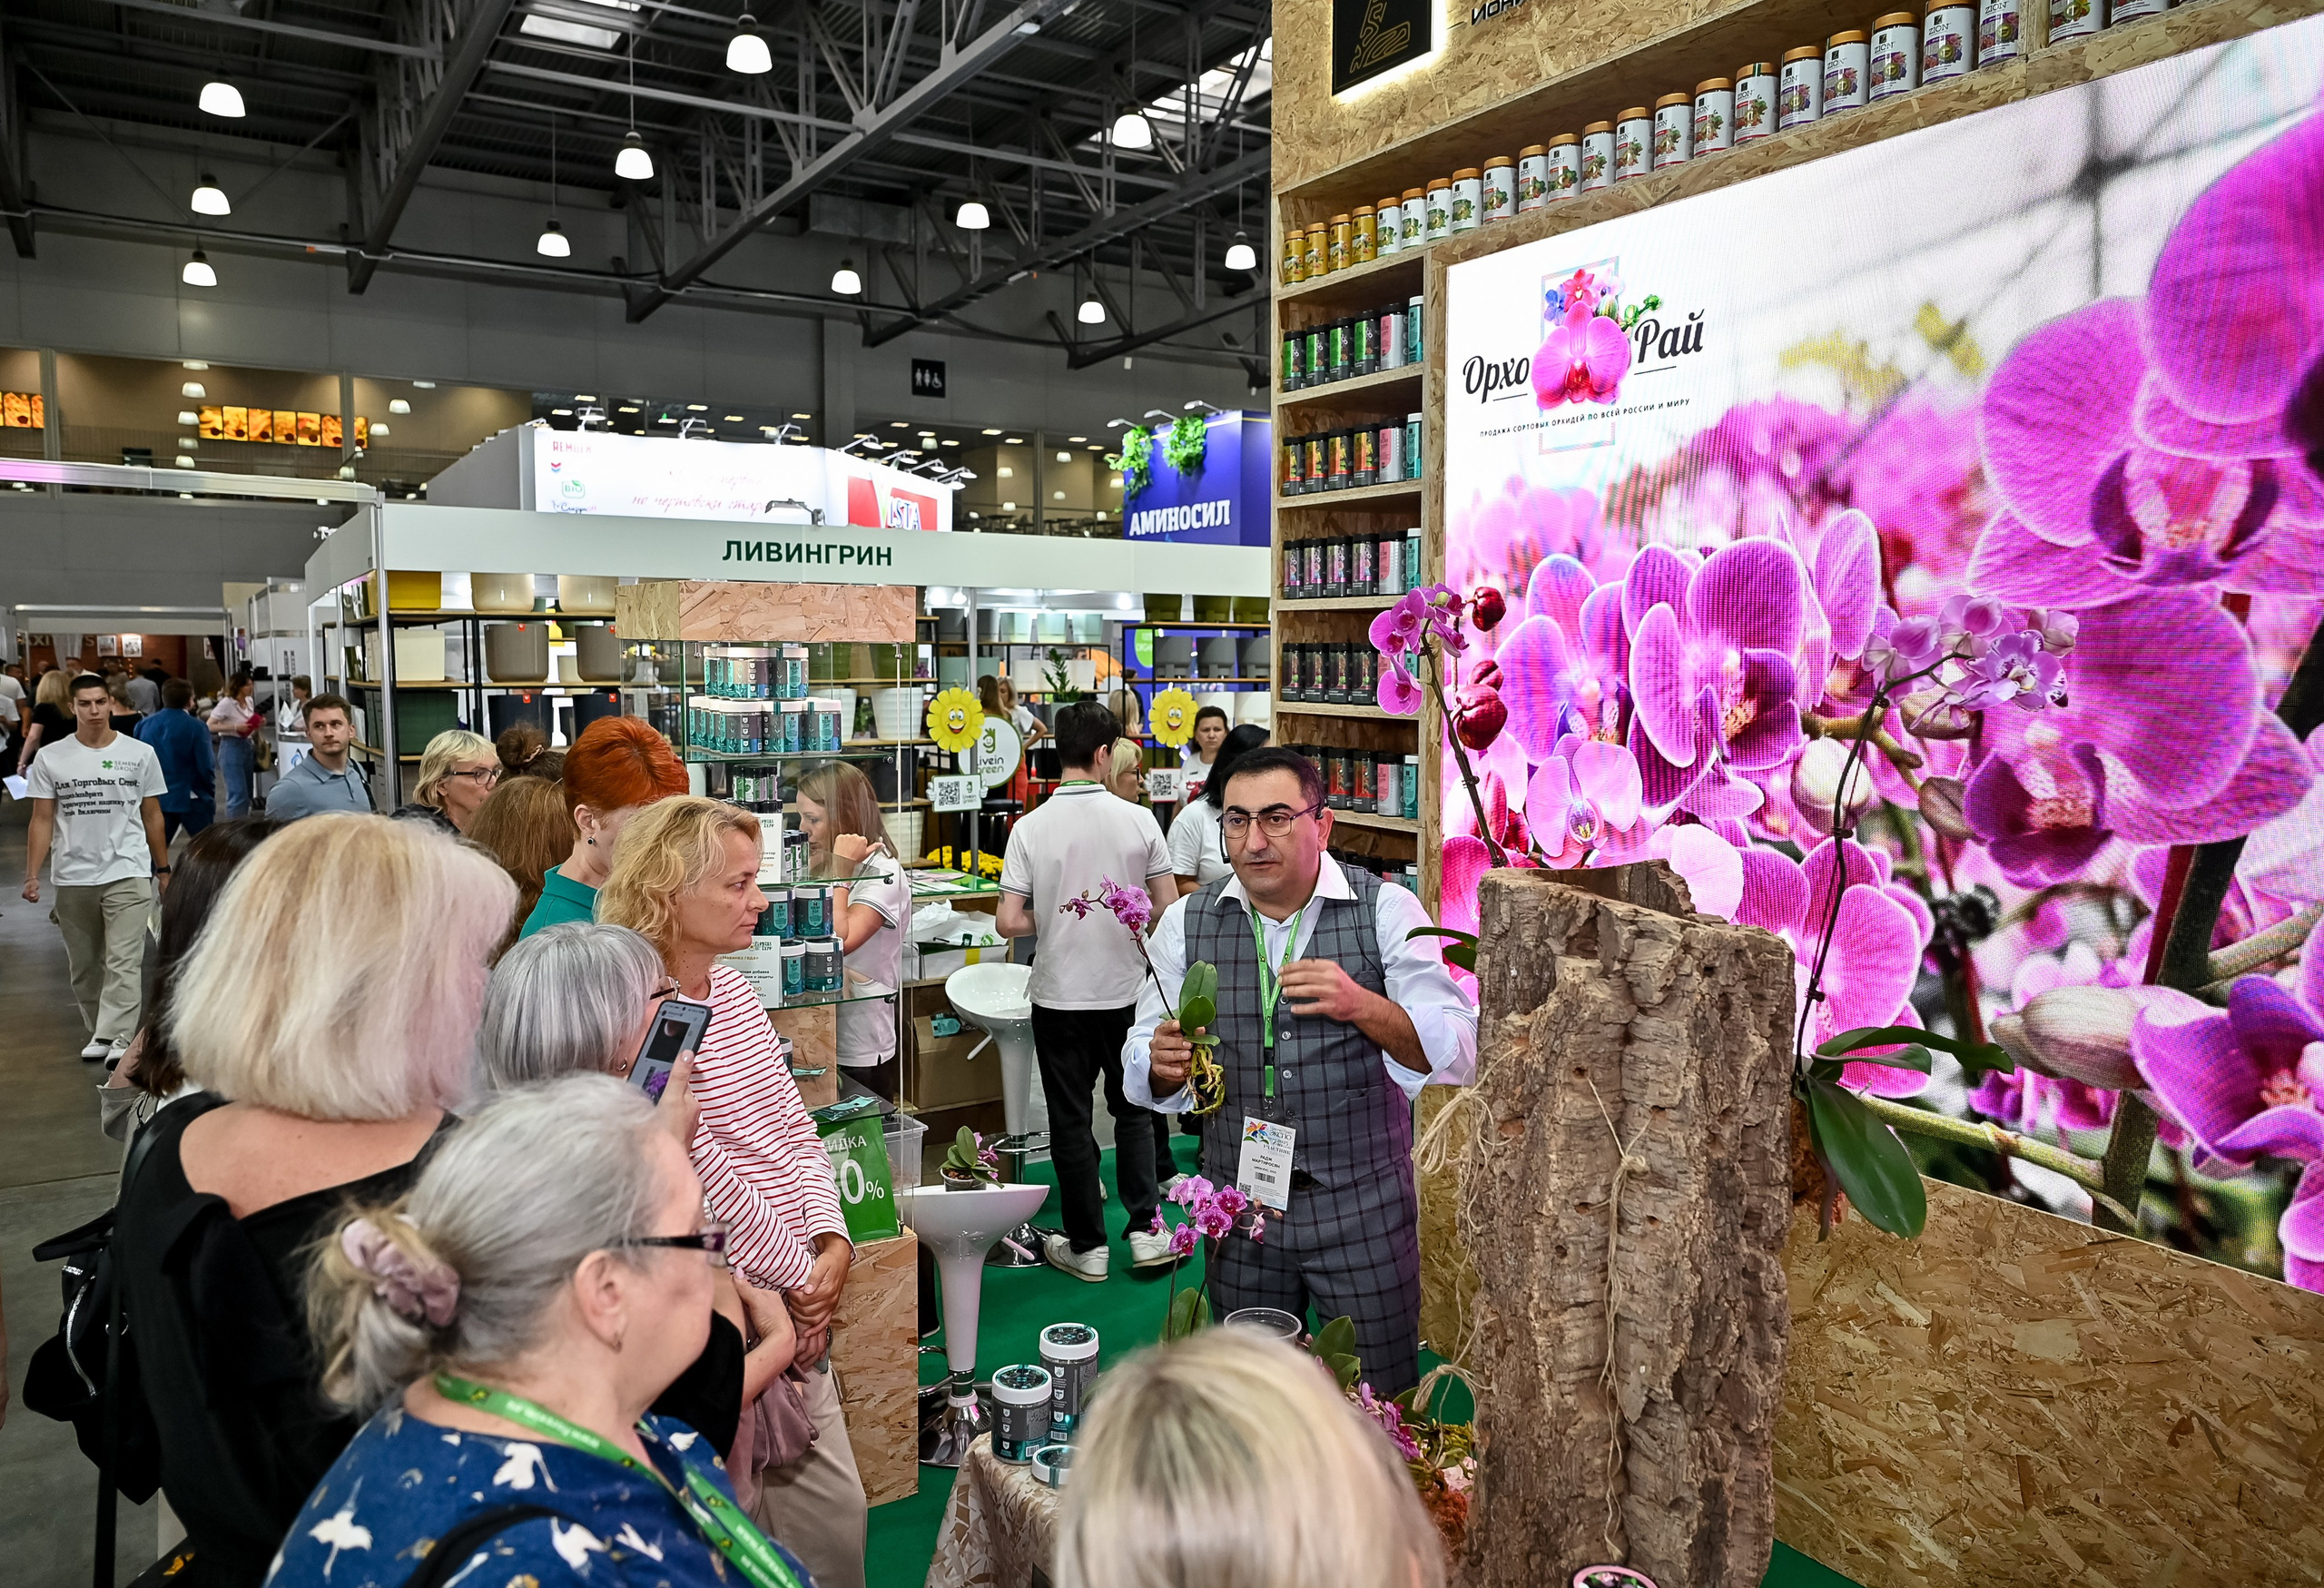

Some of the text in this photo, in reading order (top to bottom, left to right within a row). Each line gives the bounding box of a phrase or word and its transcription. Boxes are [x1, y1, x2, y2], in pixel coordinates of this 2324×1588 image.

[1984, 1, 2008, 15] ZION
[1928, 23, 1950, 36] ZION
[1874, 42, 1895, 54] ZION
[1634, 309, 1705, 363] Рай
[1462, 355, 1530, 404] Орхо
[1480, 427, 1511, 438] ПРОДАЖА
[1513, 420, 1550, 432] СОРТОВЫХ
[1551, 414, 1585, 427] ОРХИДЕЙ
[1588, 411, 1598, 420] ПО
[1600, 408, 1621, 419] ВСЕЙ
[1623, 403, 1655, 415] РОССИИ
[1667, 398, 1690, 409] МИРУ
[1129, 499, 1231, 537] АМИНОСИЛ
[722, 540, 893, 567] ЛИВИНГРИН
[72, 777, 115, 788] Торговых
[824, 1135, 867, 1153] ИДКА
